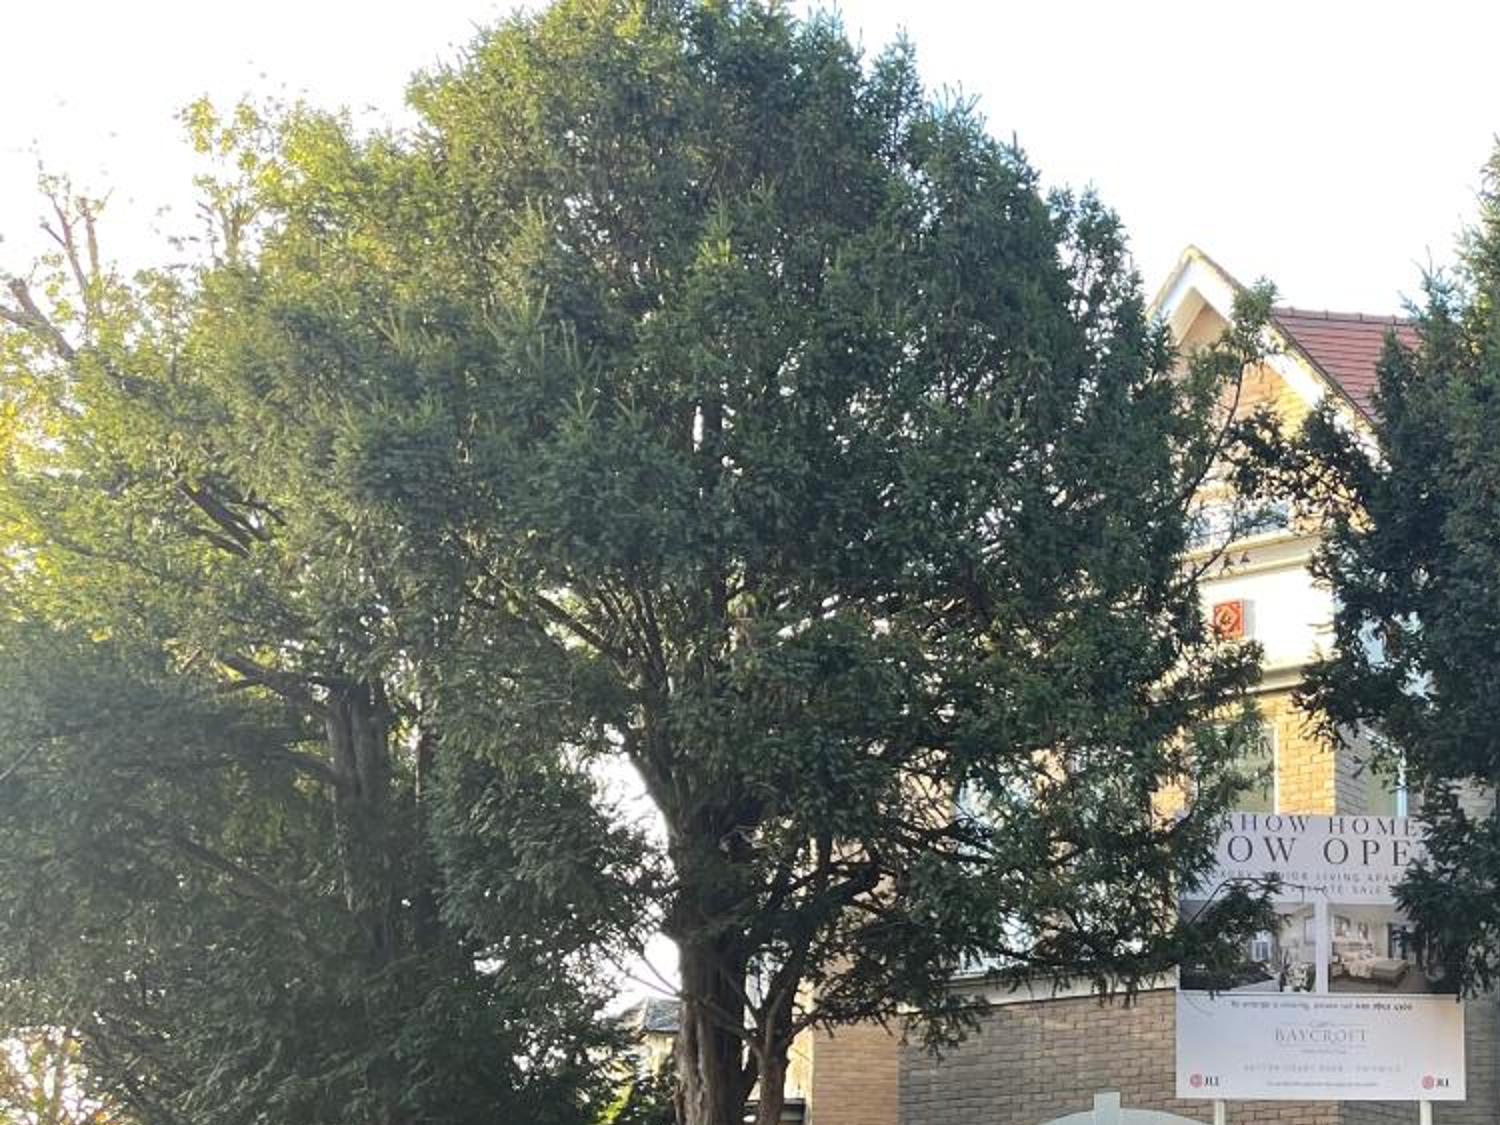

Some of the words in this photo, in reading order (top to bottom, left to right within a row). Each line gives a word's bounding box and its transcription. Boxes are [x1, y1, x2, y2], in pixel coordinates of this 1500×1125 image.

[1328, 817, 1418, 836] HOME
[1226, 835, 1297, 863] OW
[1322, 837, 1412, 867] OPE
[1274, 1028, 1368, 1044] BAYCROFT
